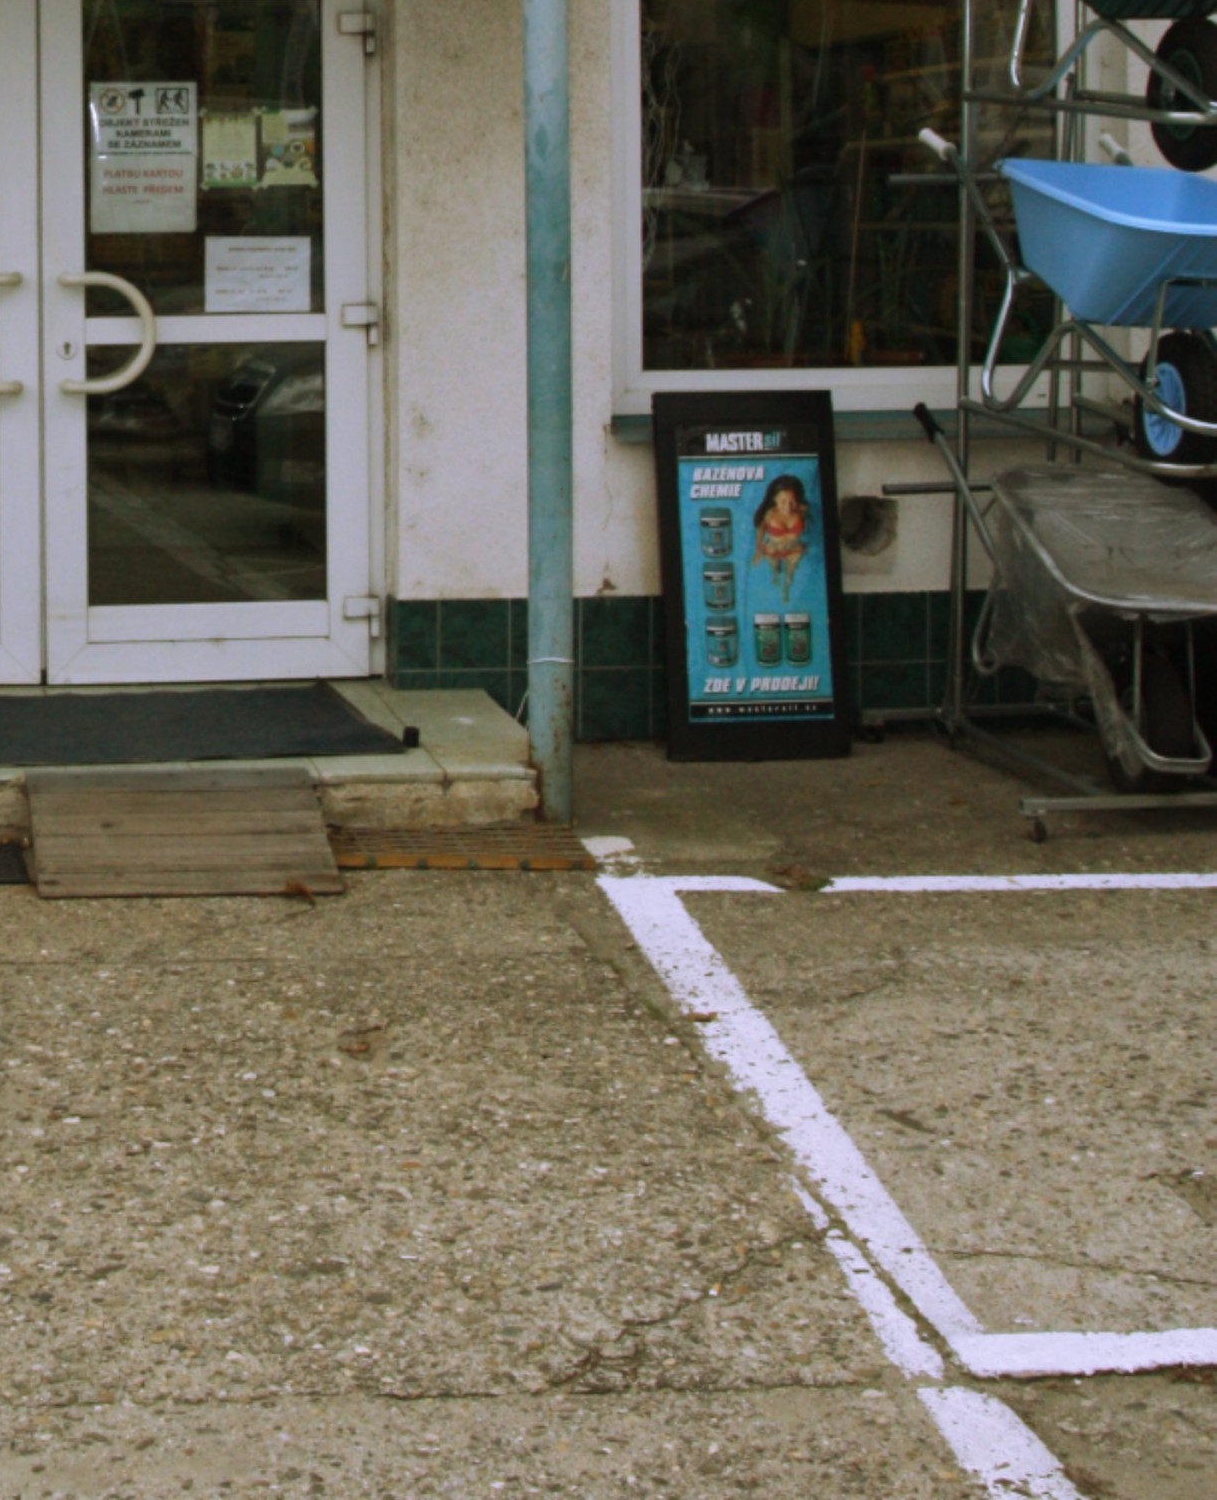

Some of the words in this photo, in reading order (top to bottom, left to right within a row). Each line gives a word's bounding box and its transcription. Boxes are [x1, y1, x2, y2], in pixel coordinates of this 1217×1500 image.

[115, 129, 171, 138] KAMERAMI
[692, 464, 765, 483] BAZÉNOVÁ
[690, 483, 742, 499] CHEMIE
[703, 677, 731, 693] ZDE
[735, 677, 747, 693] V
